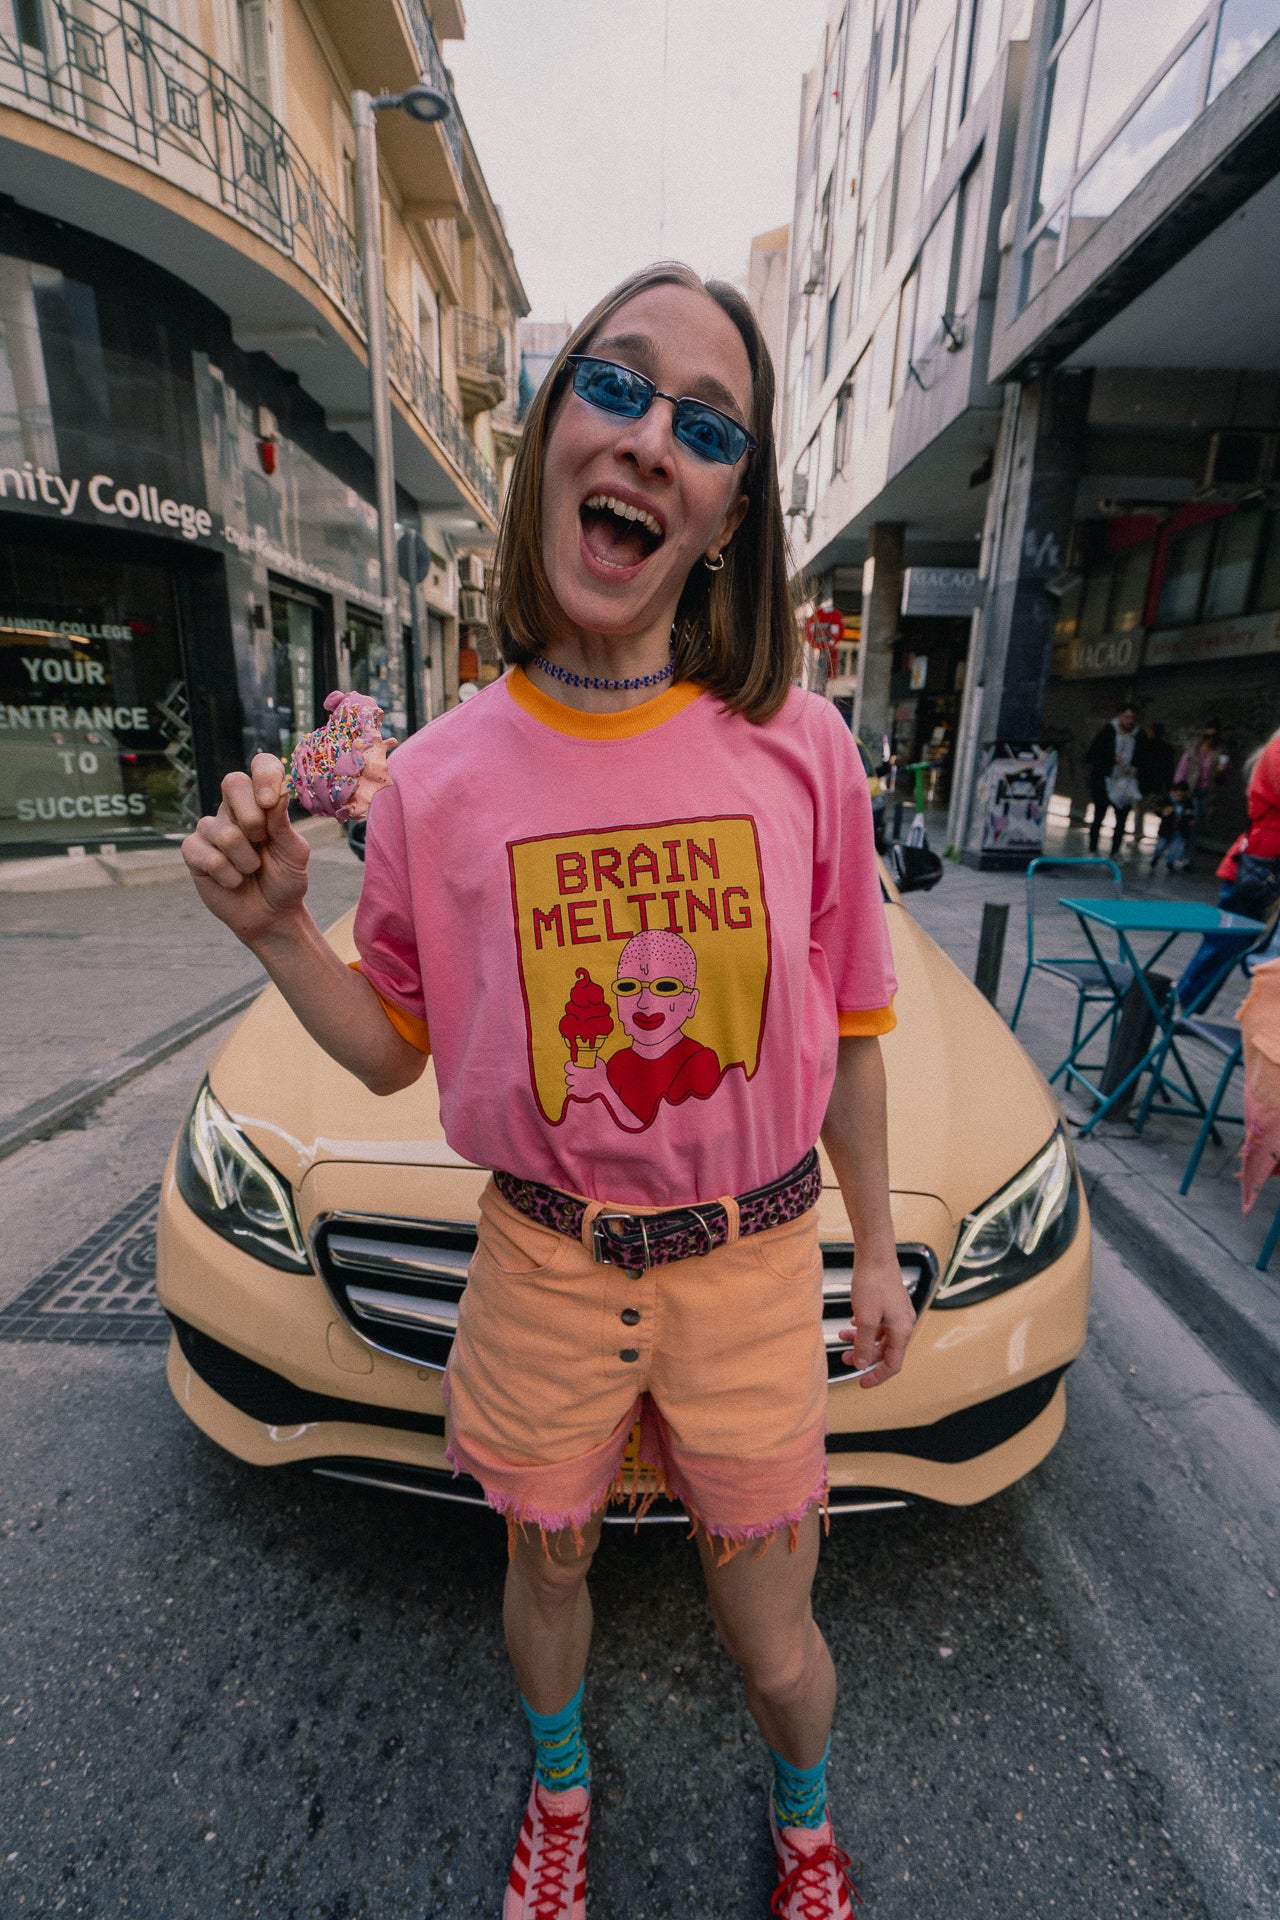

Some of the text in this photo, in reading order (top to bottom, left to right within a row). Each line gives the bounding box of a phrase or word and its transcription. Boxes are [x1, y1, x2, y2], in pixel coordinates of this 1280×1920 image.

[88, 474, 212, 539] College
[60, 621, 133, 641] COLLEGE
[21, 657, 106, 685] YOUR
[0, 704, 149, 730] ENTRANCE
[58, 751, 98, 774] TO
[17, 793, 147, 821] SUCCESS
[556, 838, 720, 895] BRAIN
[533, 887, 752, 949] MELTING
